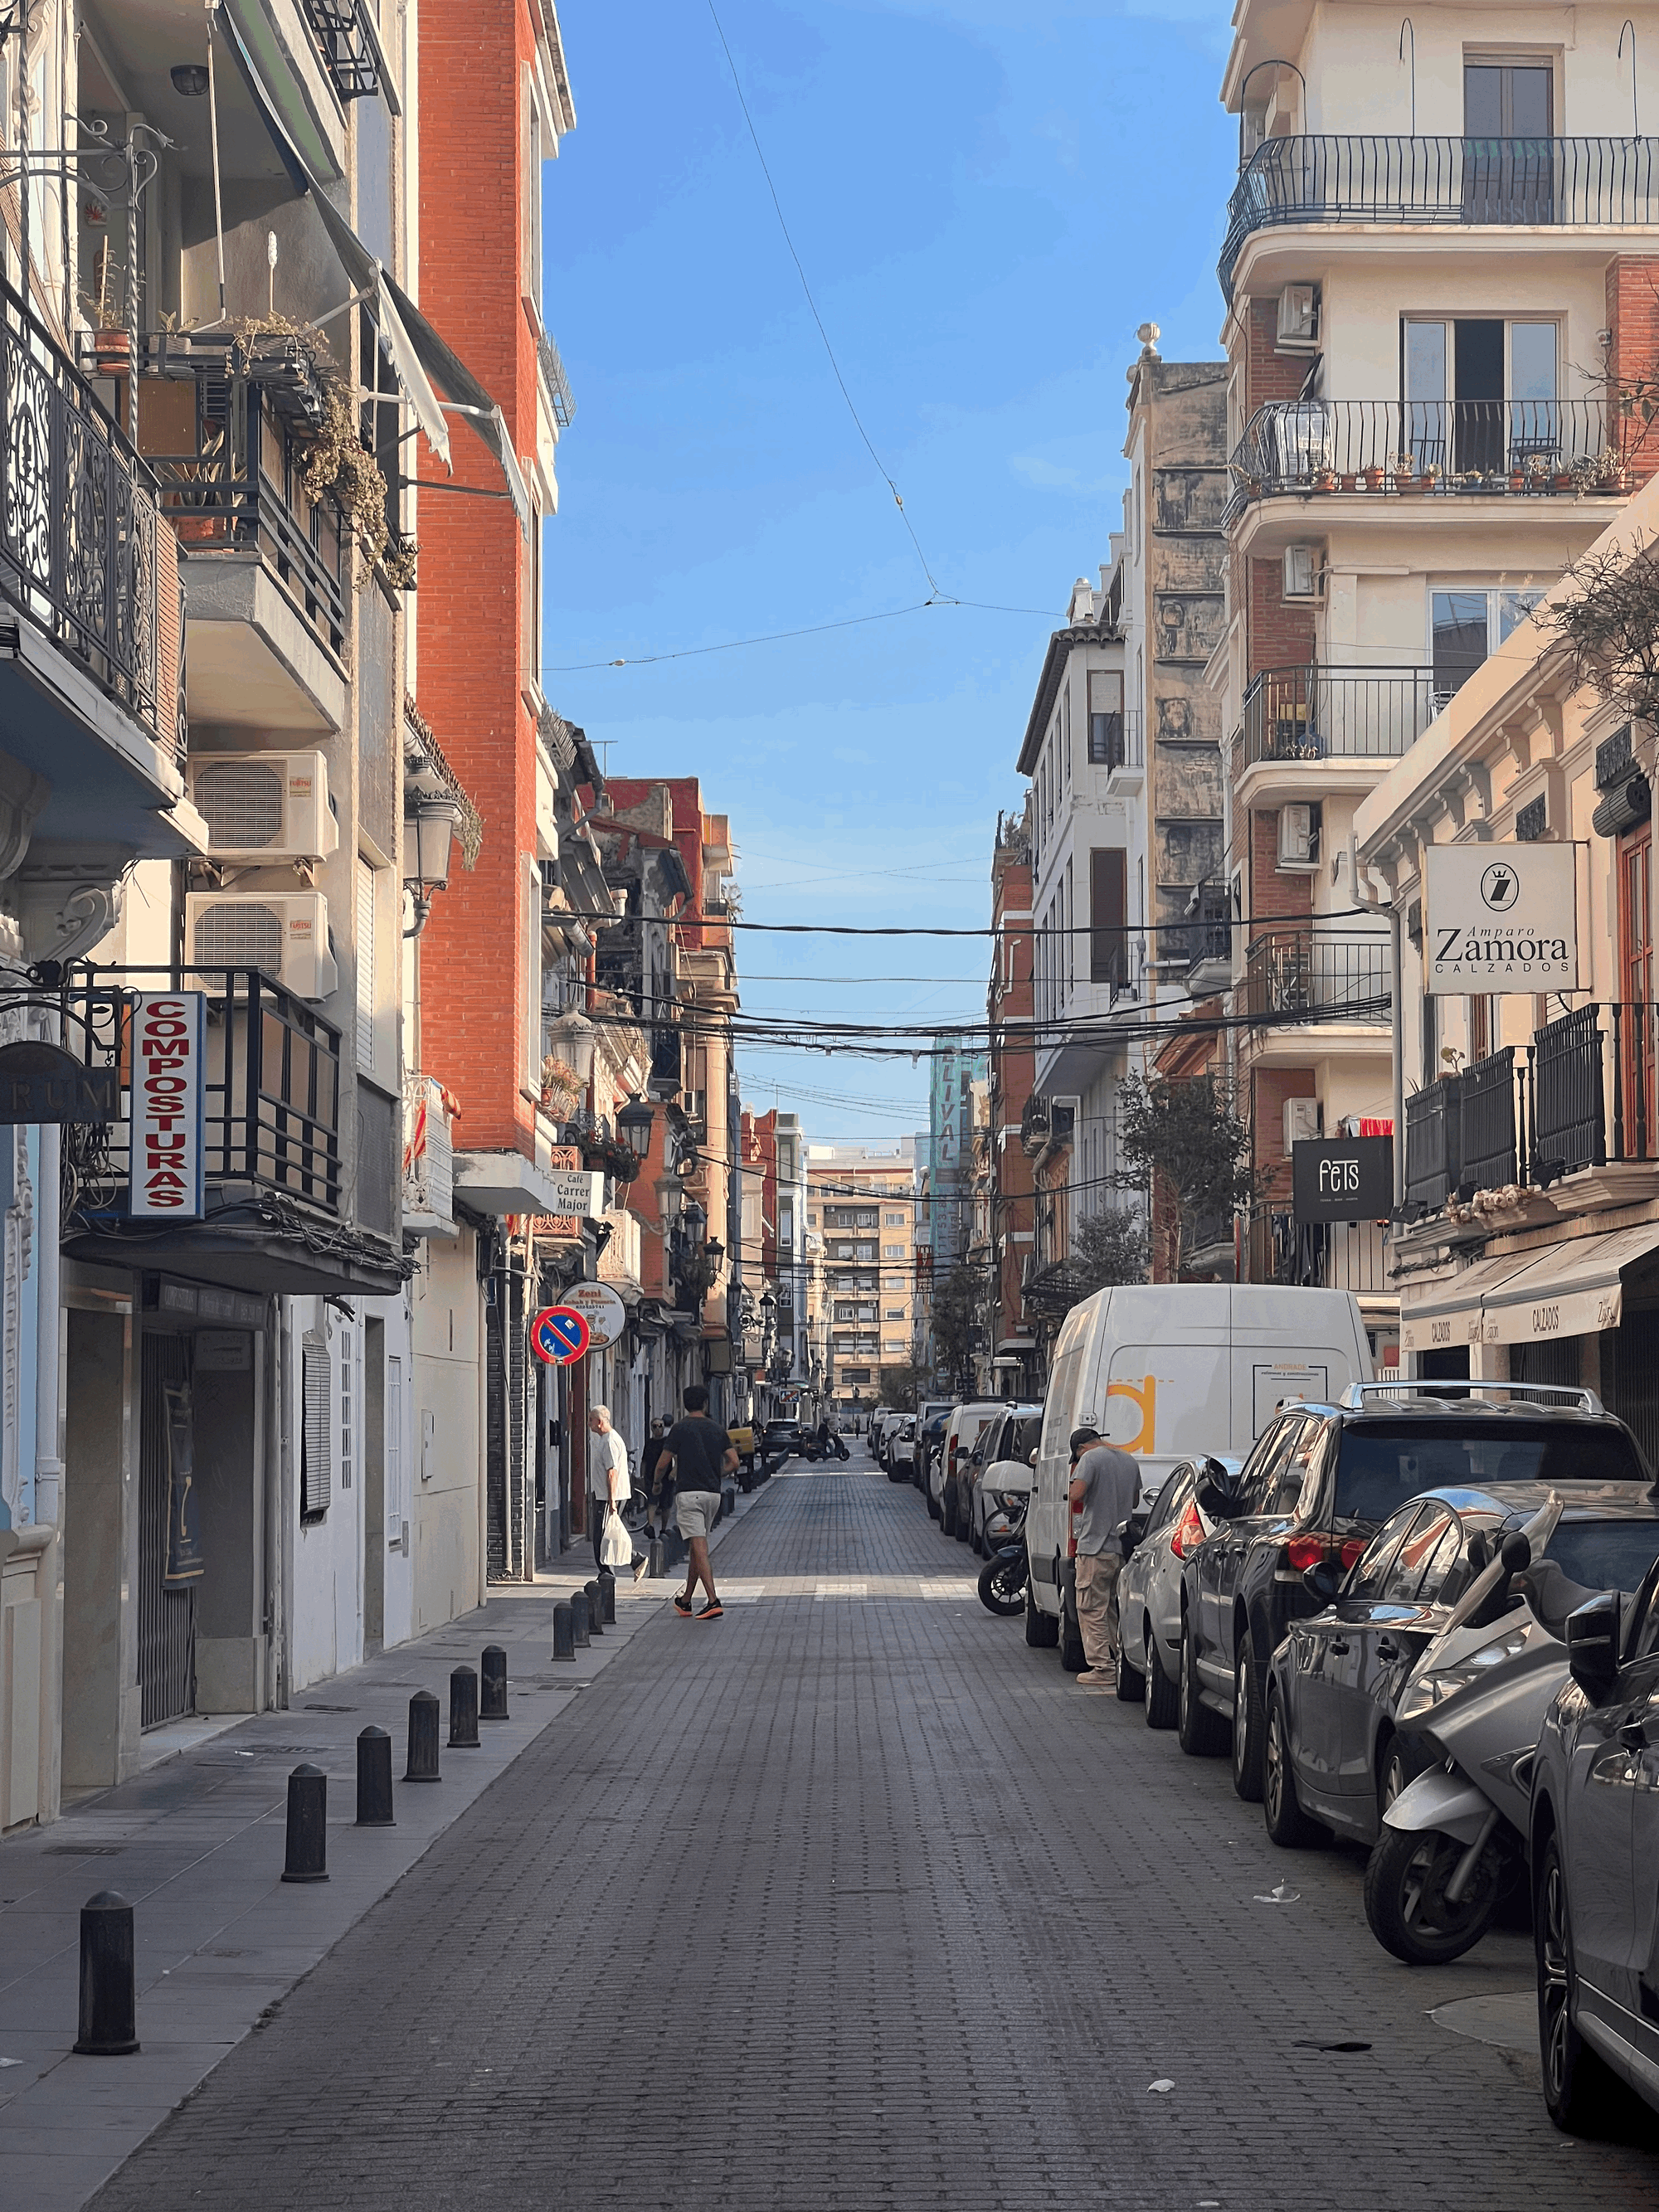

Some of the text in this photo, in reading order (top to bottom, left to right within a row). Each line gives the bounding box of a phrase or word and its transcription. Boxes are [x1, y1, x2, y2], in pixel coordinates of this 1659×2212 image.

[1467, 926, 1535, 939] Amparo
[1435, 928, 1569, 961] Zamora
[1435, 962, 1569, 974] CALZADOS
[142, 1001, 189, 1207] COMPOSTURAS
[567, 1174, 583, 1184] Café
[557, 1184, 590, 1197] Carrer
[557, 1198, 587, 1212] Major
[1533, 1305, 1559, 1333] CALZADOS
[1432, 1321, 1450, 1343] CALZADOS
